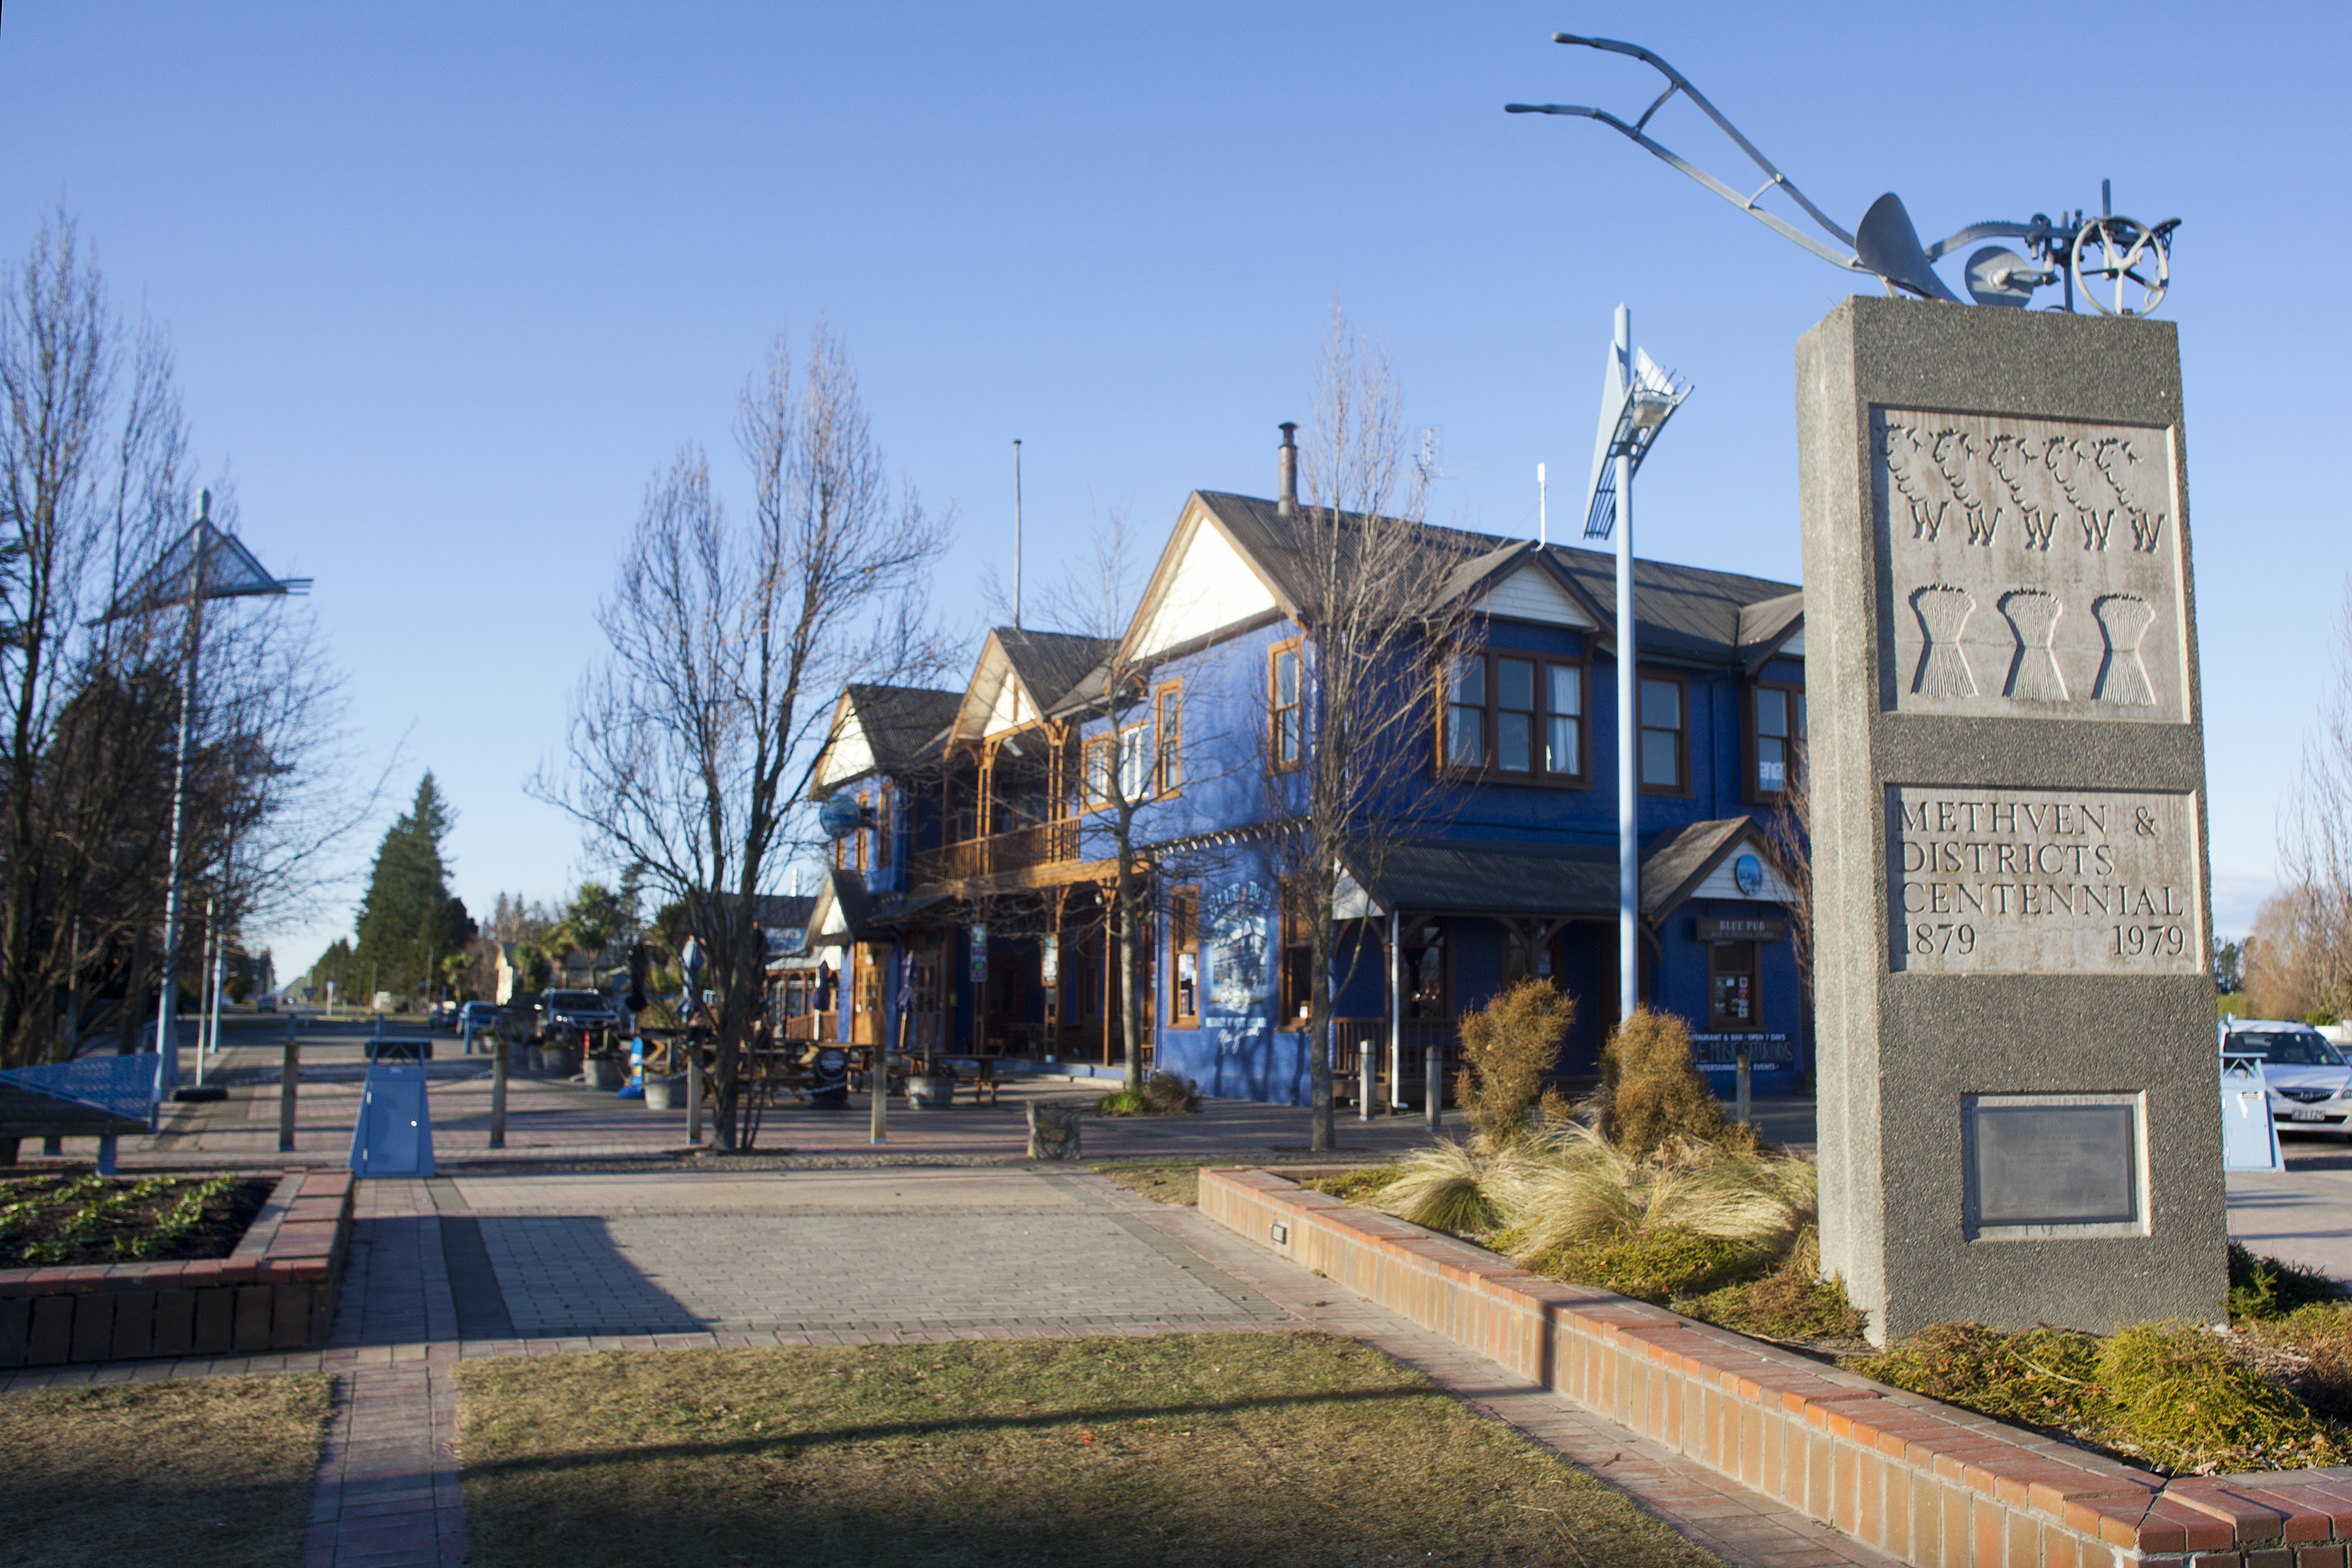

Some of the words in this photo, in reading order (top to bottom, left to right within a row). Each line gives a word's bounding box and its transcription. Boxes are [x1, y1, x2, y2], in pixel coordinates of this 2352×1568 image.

[1897, 801, 2107, 835] METHVEN
[2135, 806, 2159, 837] &
[1898, 842, 2114, 875] DISTRICTS
[1904, 882, 2184, 916] CENTENNIAL
[1719, 920, 1743, 931] BLUE
[1747, 921, 1765, 932] PUB
[1899, 923, 1977, 954] 1879
[2113, 924, 2186, 956] 1979
